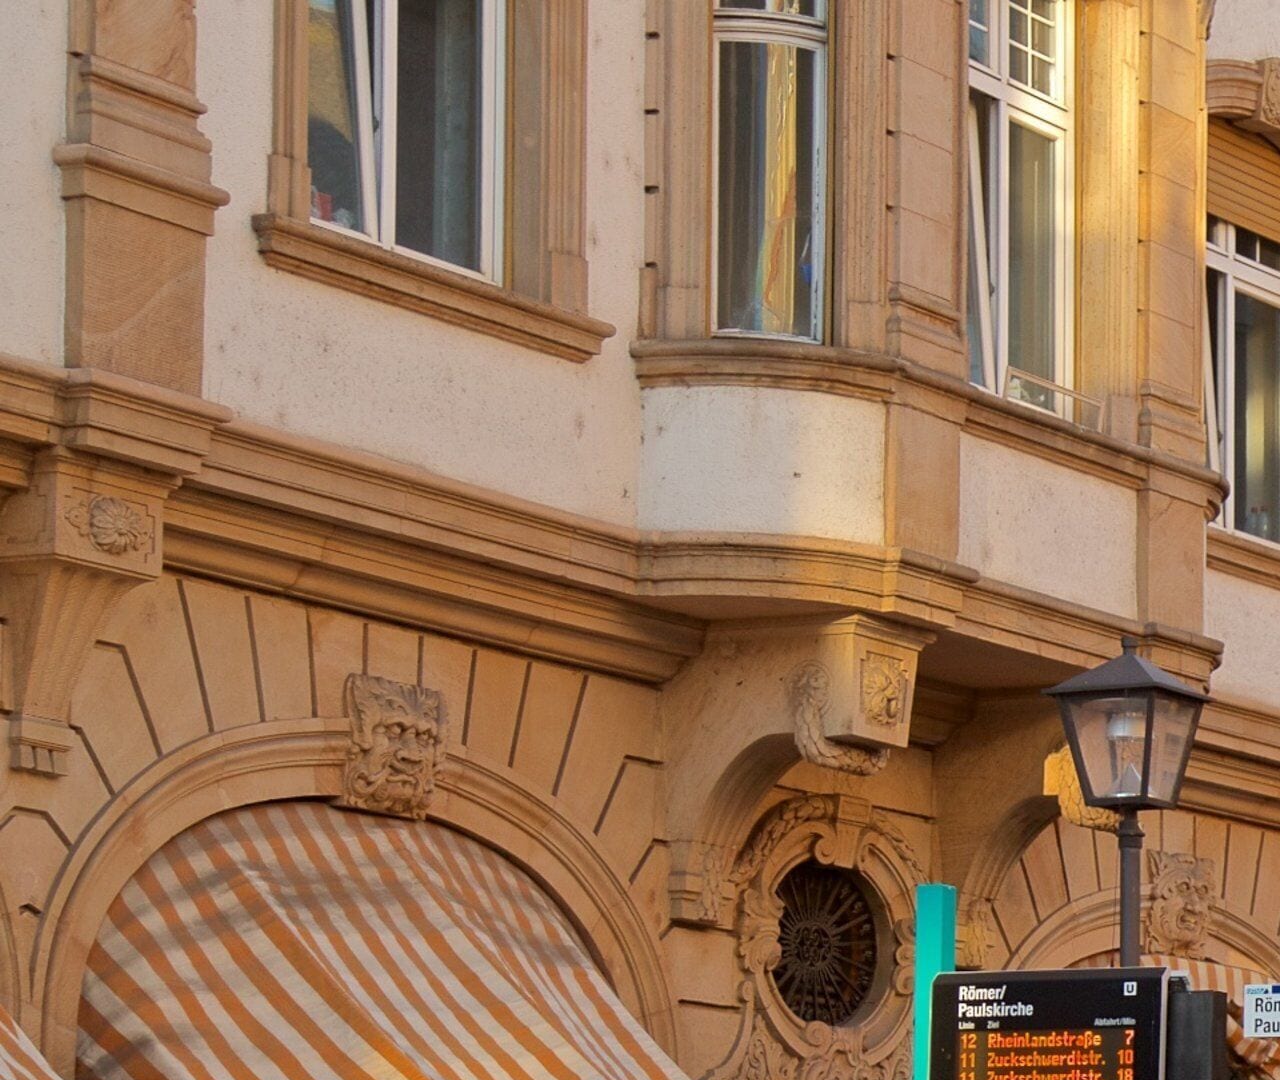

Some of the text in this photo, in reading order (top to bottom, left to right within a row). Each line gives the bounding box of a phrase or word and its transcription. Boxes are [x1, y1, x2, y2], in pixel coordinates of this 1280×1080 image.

[958, 985, 1007, 1001] Römer/
[958, 1002, 1034, 1018] Paulskirche
[960, 1030, 1135, 1049] 12 Rheinlandstraße 7
[960, 1050, 1134, 1068] 11 Zuckschwerdtstr. 10
